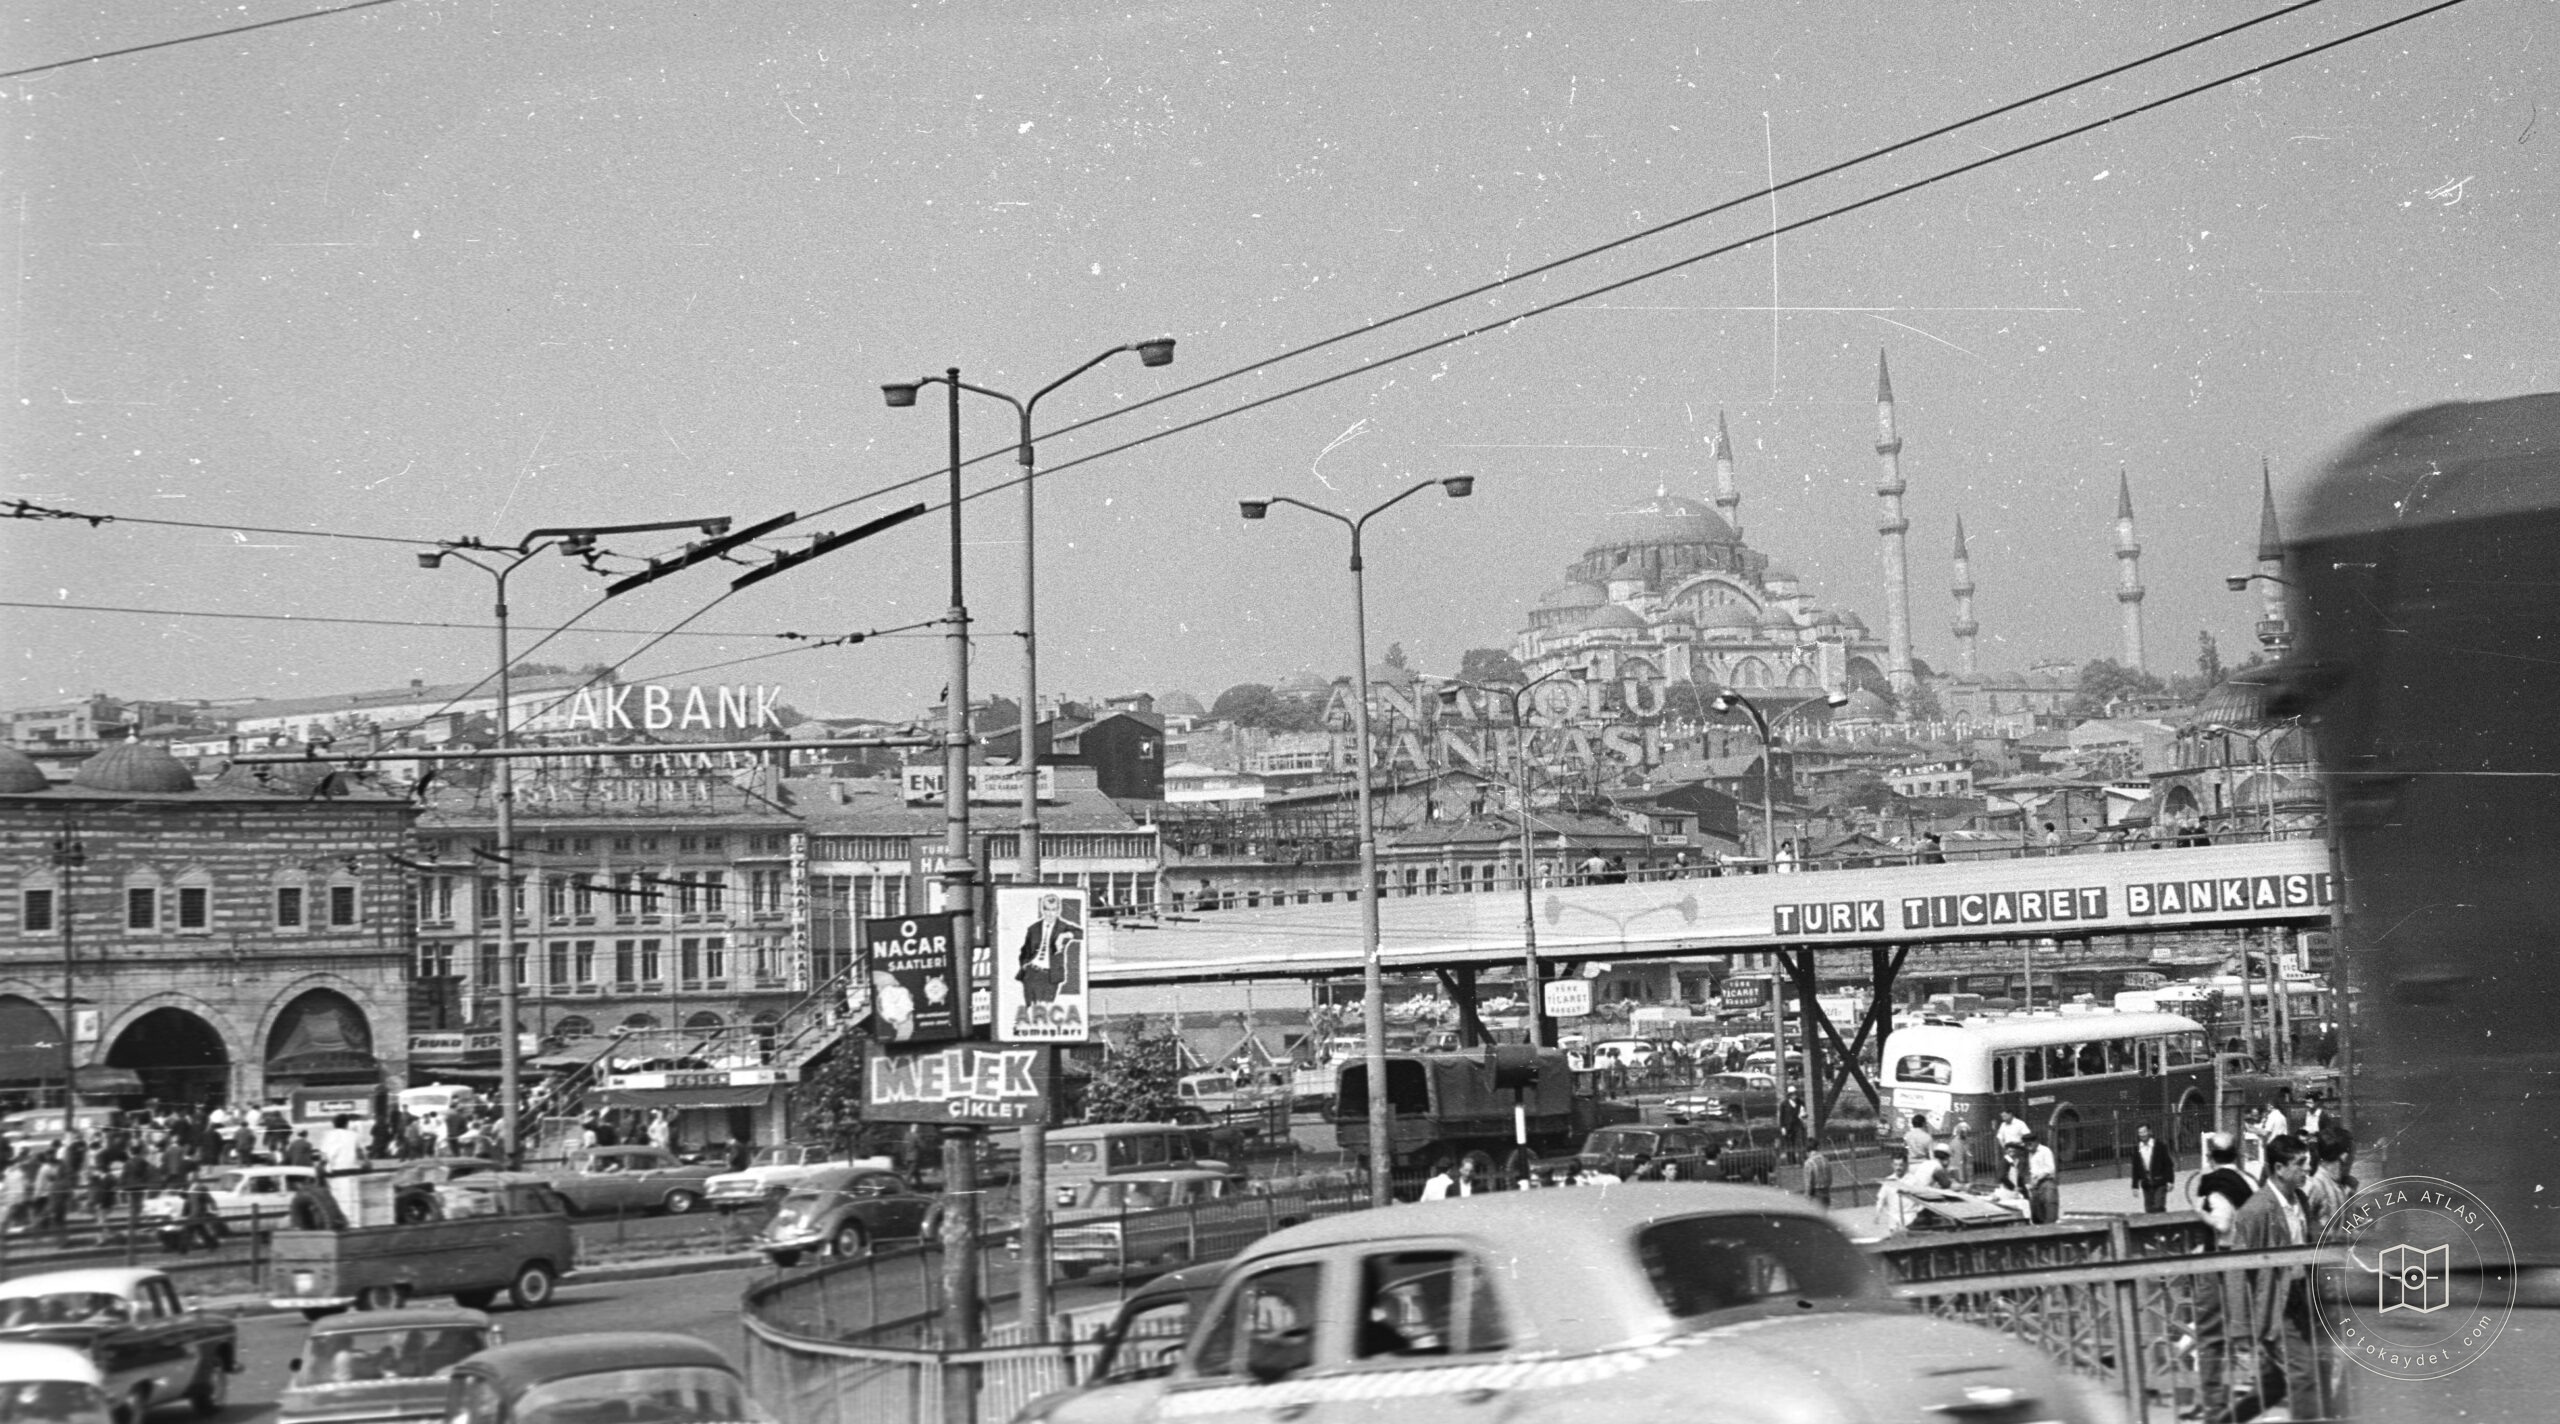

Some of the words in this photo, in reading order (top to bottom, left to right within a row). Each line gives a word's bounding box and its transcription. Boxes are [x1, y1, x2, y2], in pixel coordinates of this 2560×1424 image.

[567, 684, 782, 730] AKBANK
[1321, 677, 1666, 724] ANADOLU
[1332, 725, 1662, 770] BANKASI
[1776, 901, 1880, 933] TURK
[1904, 888, 2102, 926] TICARET
[873, 936, 947, 959] NACAR
[888, 956, 947, 972] SAATLERİ
[871, 1049, 1039, 1105] MELEK
[948, 1101, 1028, 1119] ÇİKLET
